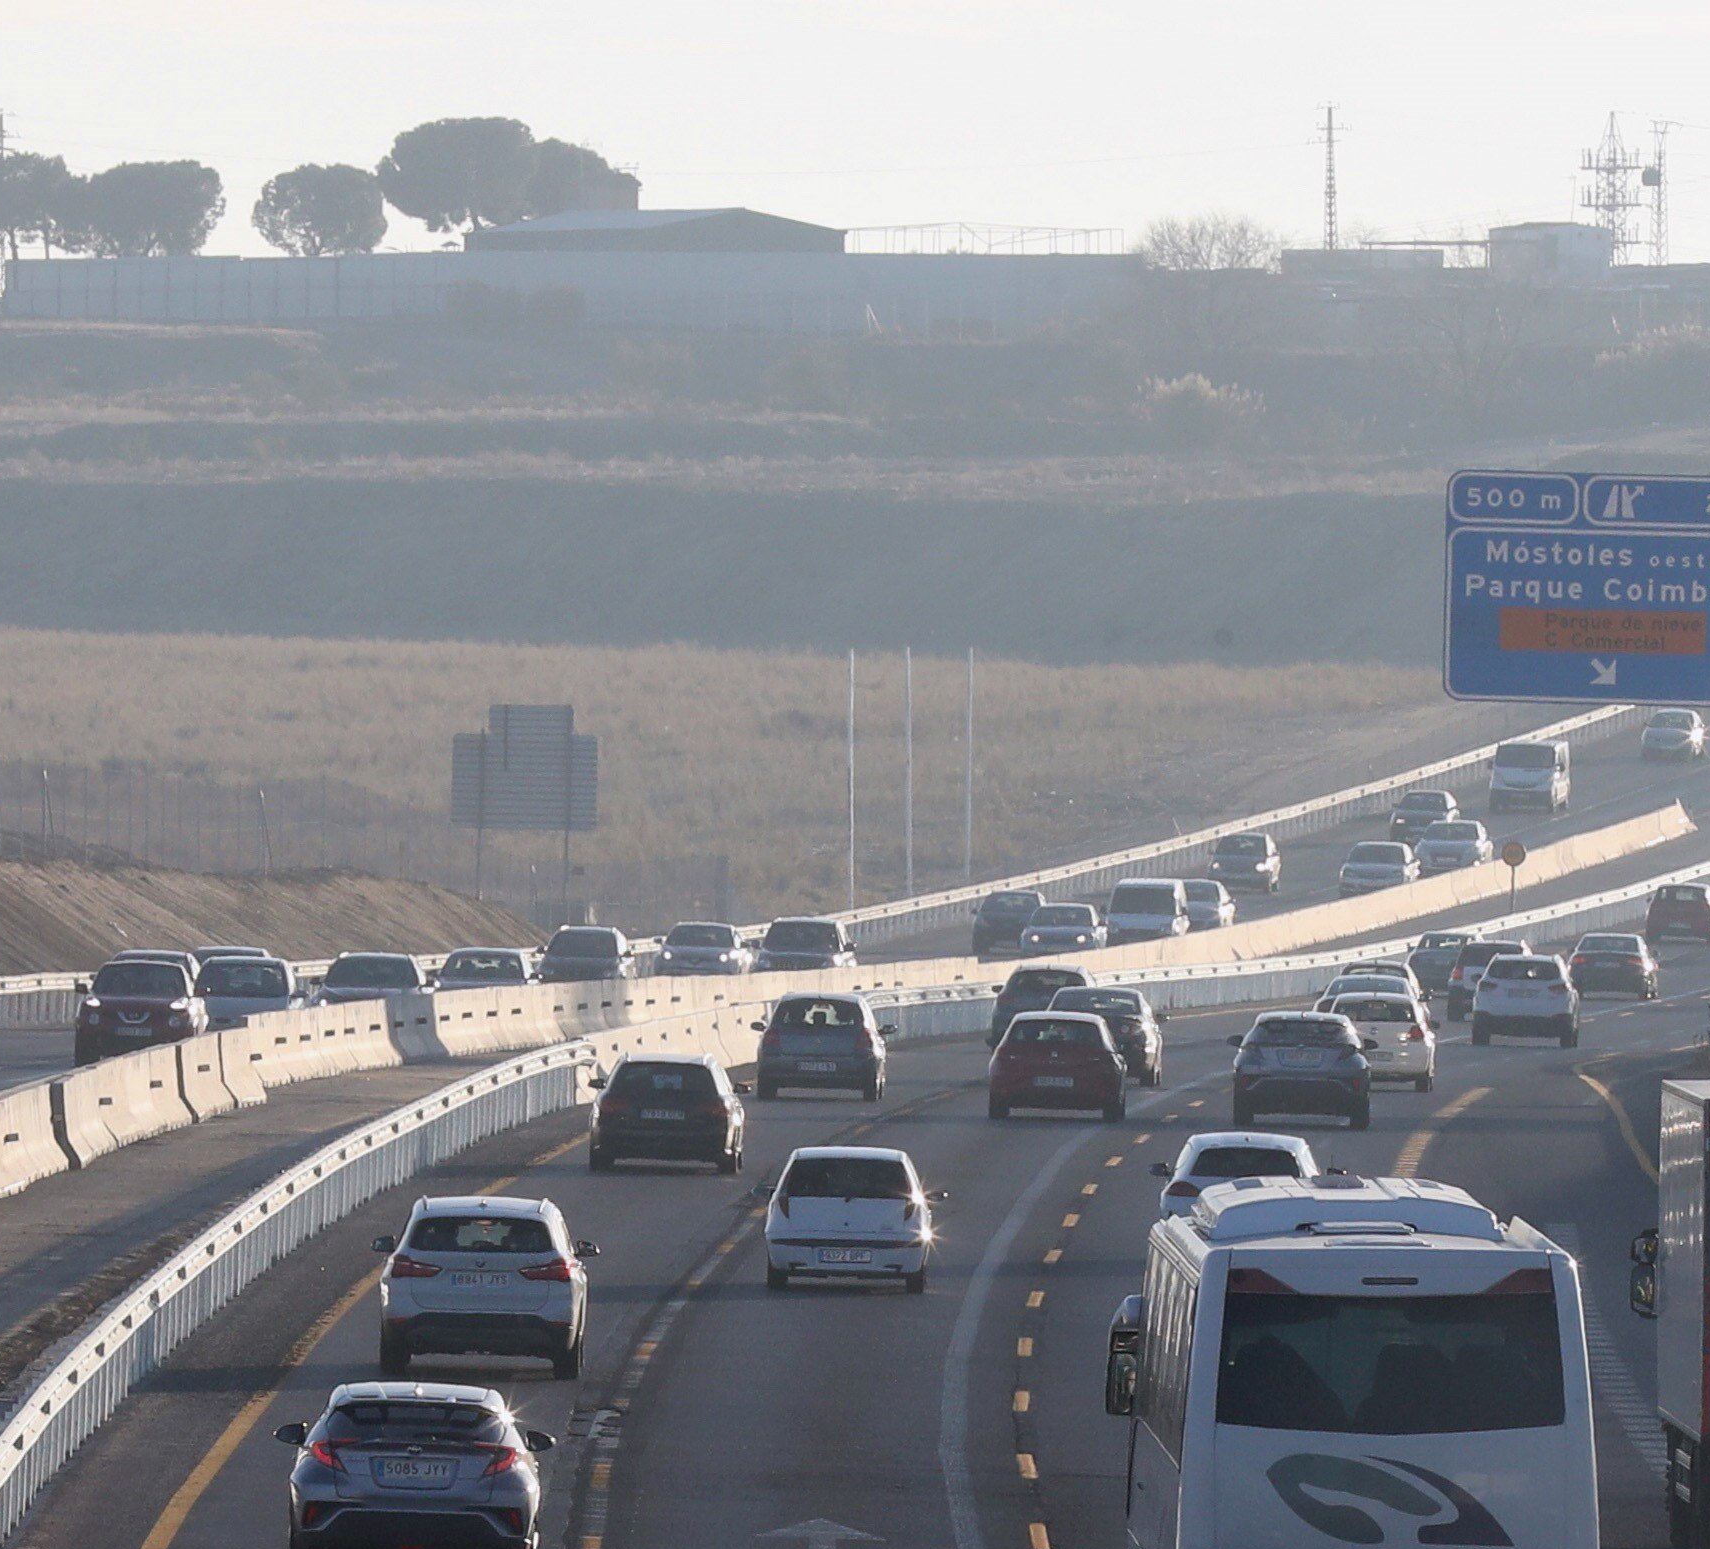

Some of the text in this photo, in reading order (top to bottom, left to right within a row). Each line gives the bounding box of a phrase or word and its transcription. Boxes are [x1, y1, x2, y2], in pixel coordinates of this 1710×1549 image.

[1466, 487, 1561, 509] 500 m
[1486, 540, 1634, 566] Móstoles
[1465, 574, 1584, 603] Parque
[1544, 613, 1703, 631] Parque de nieve
[1571, 632, 1666, 650] Comercial
[425, 1463, 447, 1476] JYY
